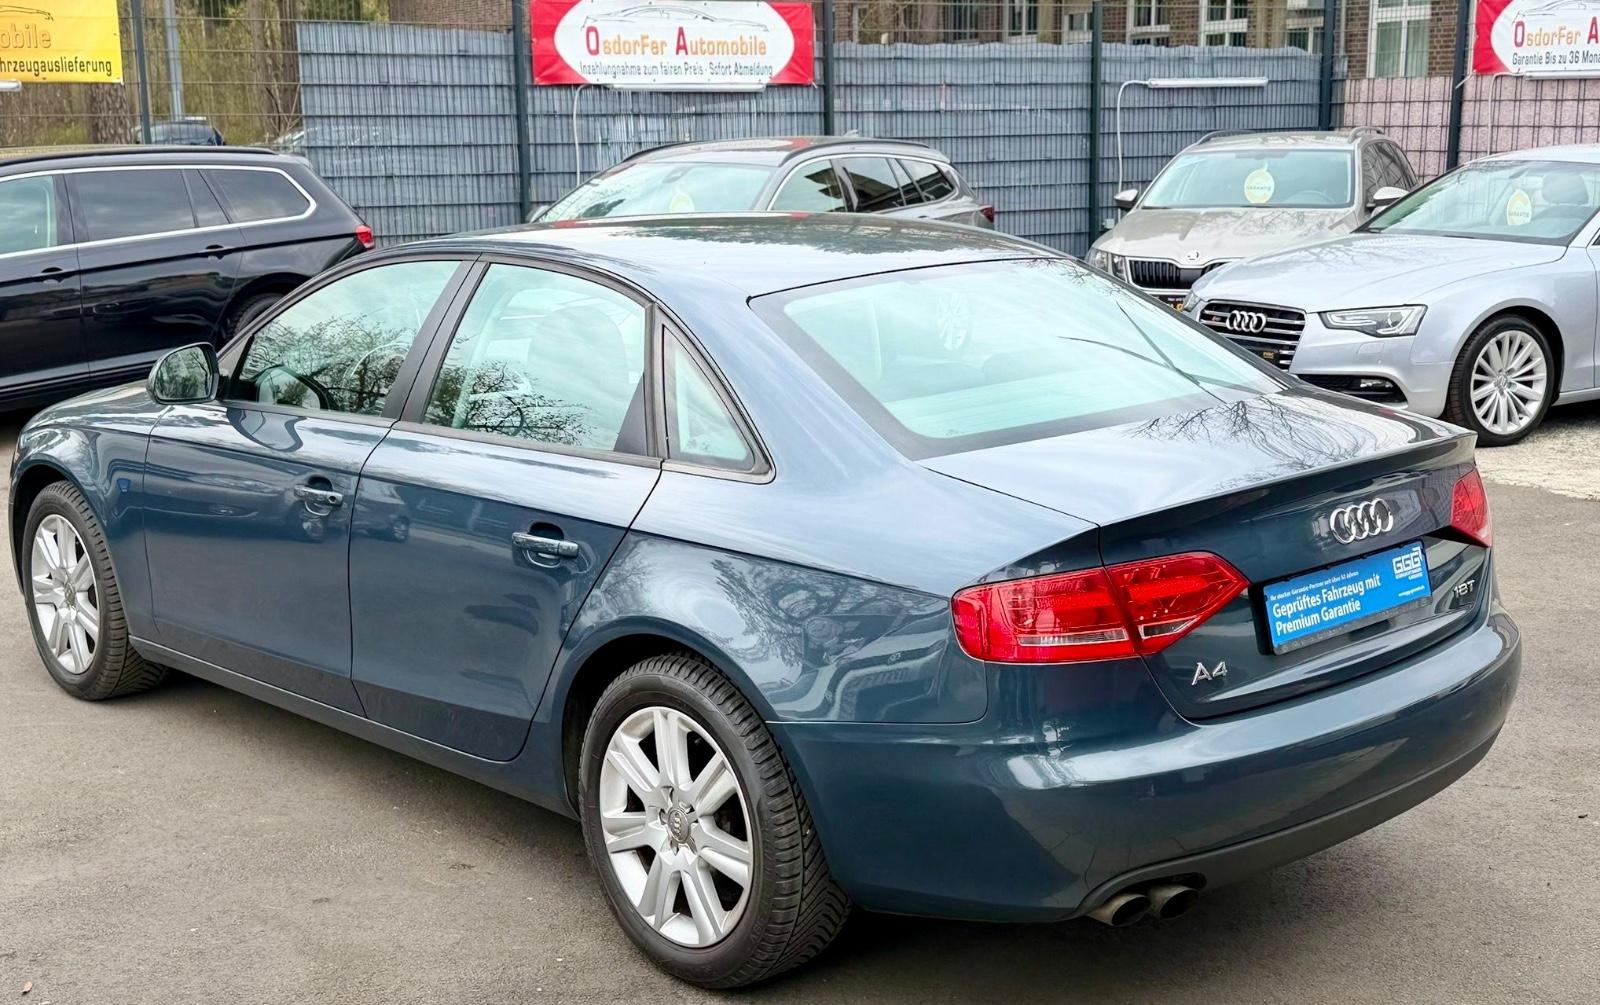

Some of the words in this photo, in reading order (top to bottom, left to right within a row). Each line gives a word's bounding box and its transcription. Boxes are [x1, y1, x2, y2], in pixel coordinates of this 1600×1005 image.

[676, 26, 767, 56] Automobile
[580, 61, 641, 79] Inzahlungnahme
[643, 65, 658, 76] zum
[660, 61, 683, 76] fairen
[684, 61, 704, 76] Preis
[709, 61, 732, 76] Sofort
[734, 61, 773, 79] Abmeldung
[1512, 53, 1543, 65] Garantie
[1545, 52, 1556, 64] Bis
[1558, 53, 1567, 64] zu
[1569, 51, 1580, 64] 36
[1392, 550, 1422, 574] GGG
[1273, 594, 1321, 619] Geprüftes
[1321, 581, 1366, 603] Fahrzeug
[1365, 573, 1381, 590] mit
[1275, 613, 1321, 637] Premium
[1321, 598, 1361, 621] Garantie
[1191, 661, 1228, 686] A4
